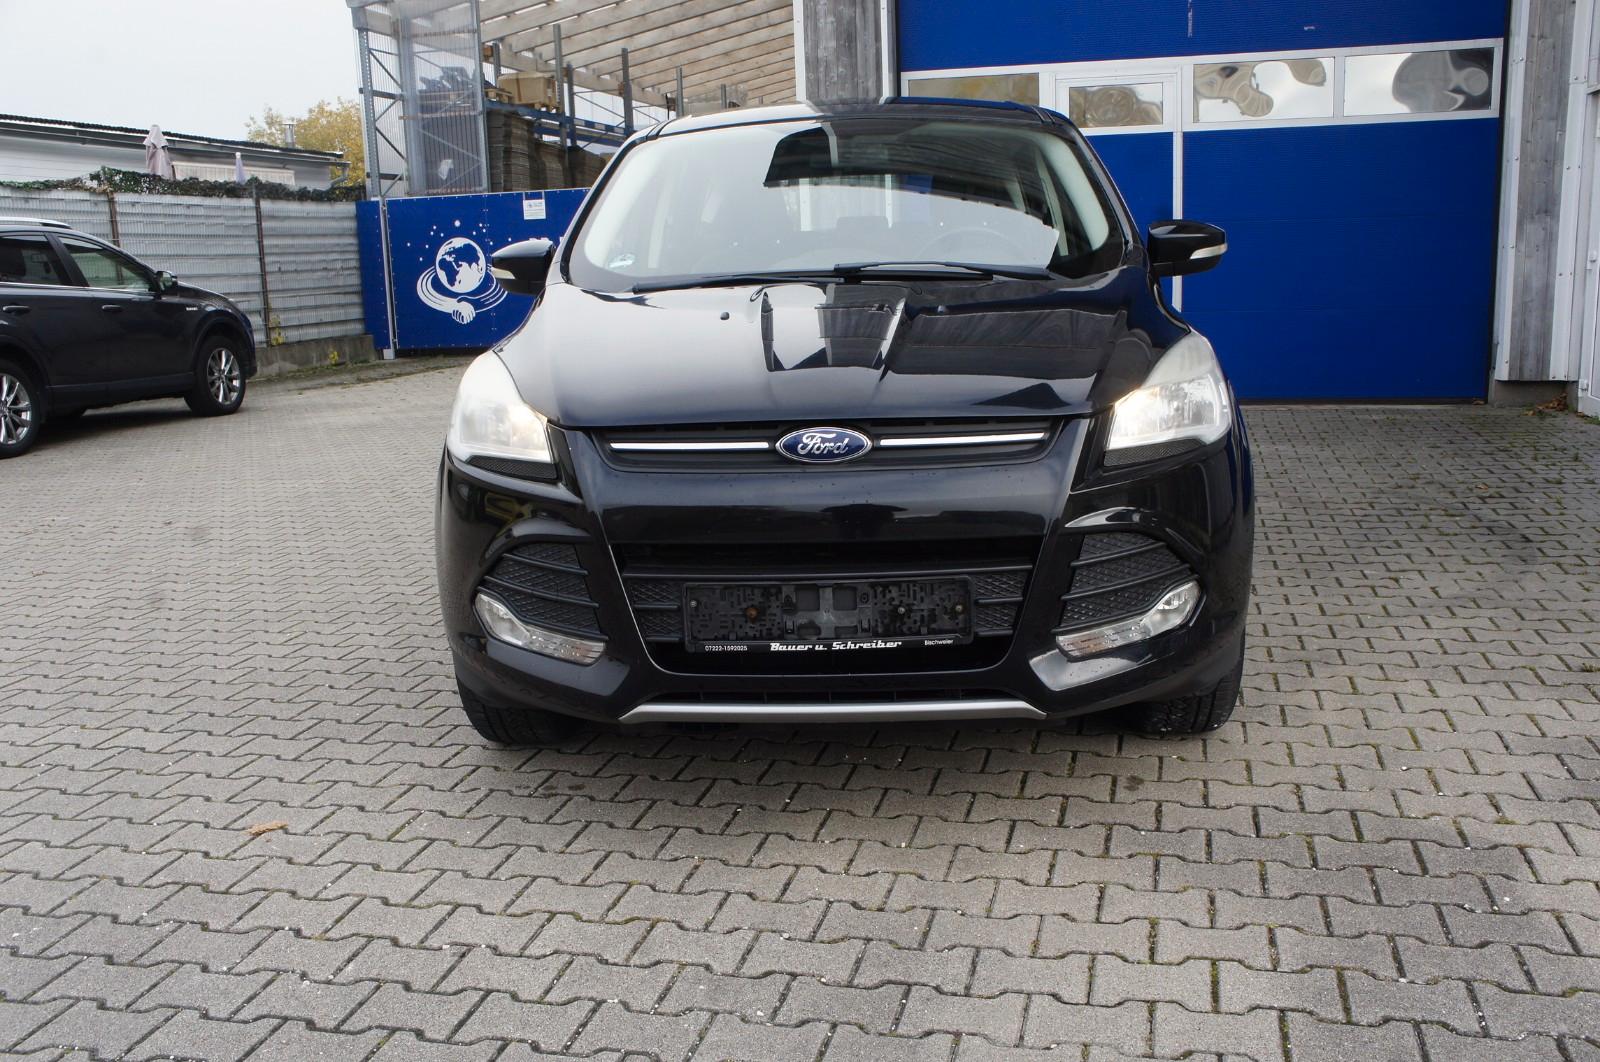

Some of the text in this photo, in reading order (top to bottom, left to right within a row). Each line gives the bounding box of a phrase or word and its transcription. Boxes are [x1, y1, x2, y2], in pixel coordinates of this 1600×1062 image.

[797, 433, 850, 454] Ford
[770, 643, 813, 651] Bauer
[832, 640, 902, 650] Schreiber
